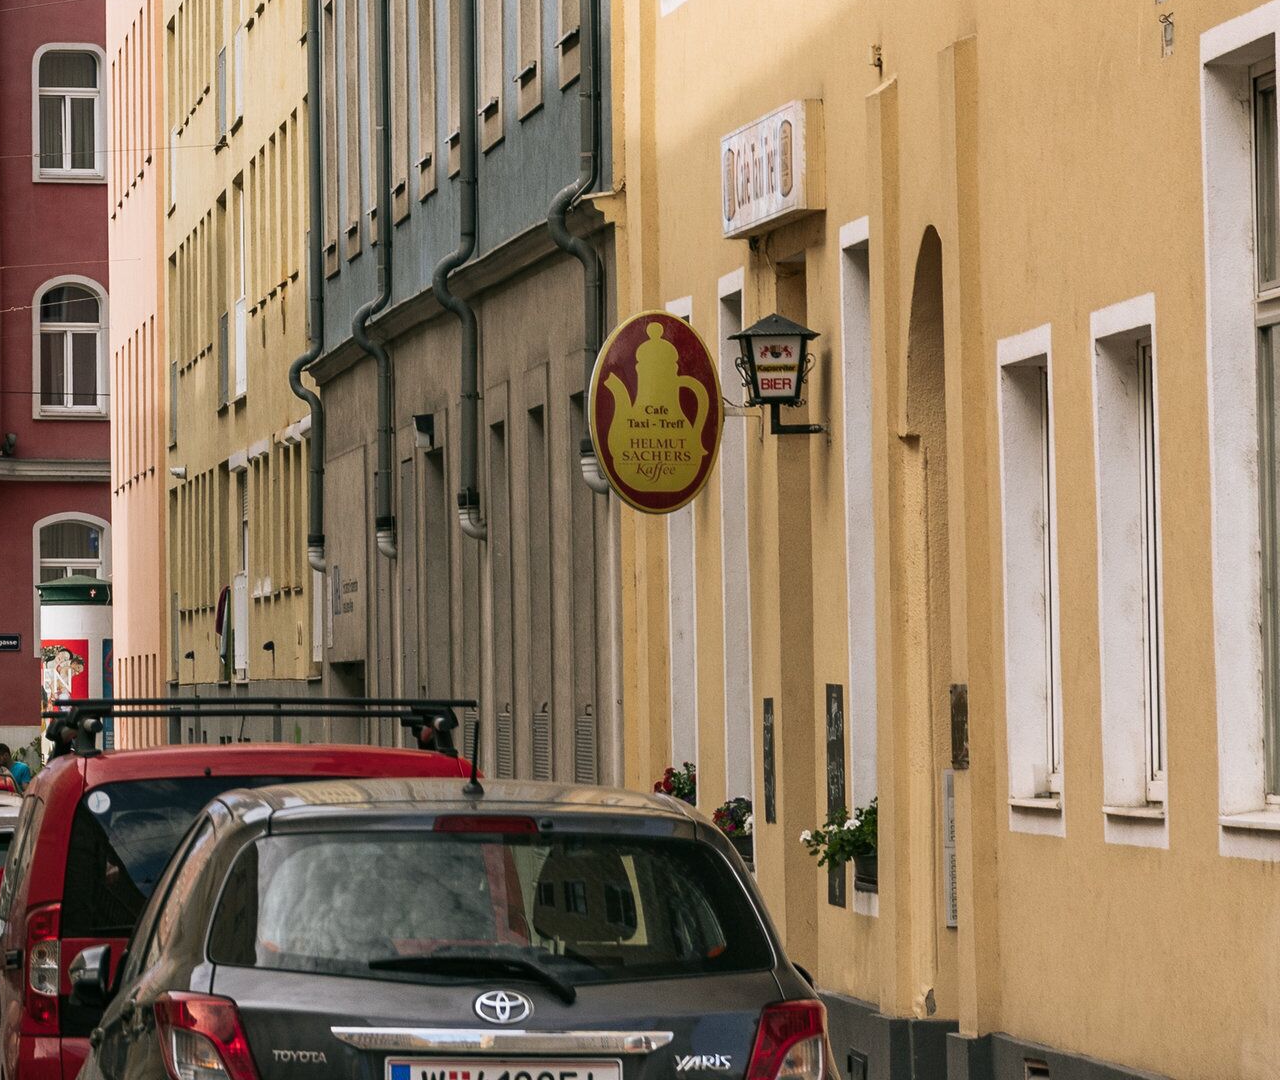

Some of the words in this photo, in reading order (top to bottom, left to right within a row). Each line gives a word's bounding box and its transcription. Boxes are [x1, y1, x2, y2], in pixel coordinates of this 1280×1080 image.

[761, 378, 792, 390] BIER
[645, 405, 669, 415] Cafe
[627, 419, 650, 429] Taxi
[659, 419, 685, 429] Treff
[630, 438, 687, 449] HELMUT
[622, 450, 691, 461] SACHERS
[636, 461, 676, 484] Kaffee
[272, 1049, 327, 1063] TOYOTA
[675, 1053, 733, 1071] YARIS
